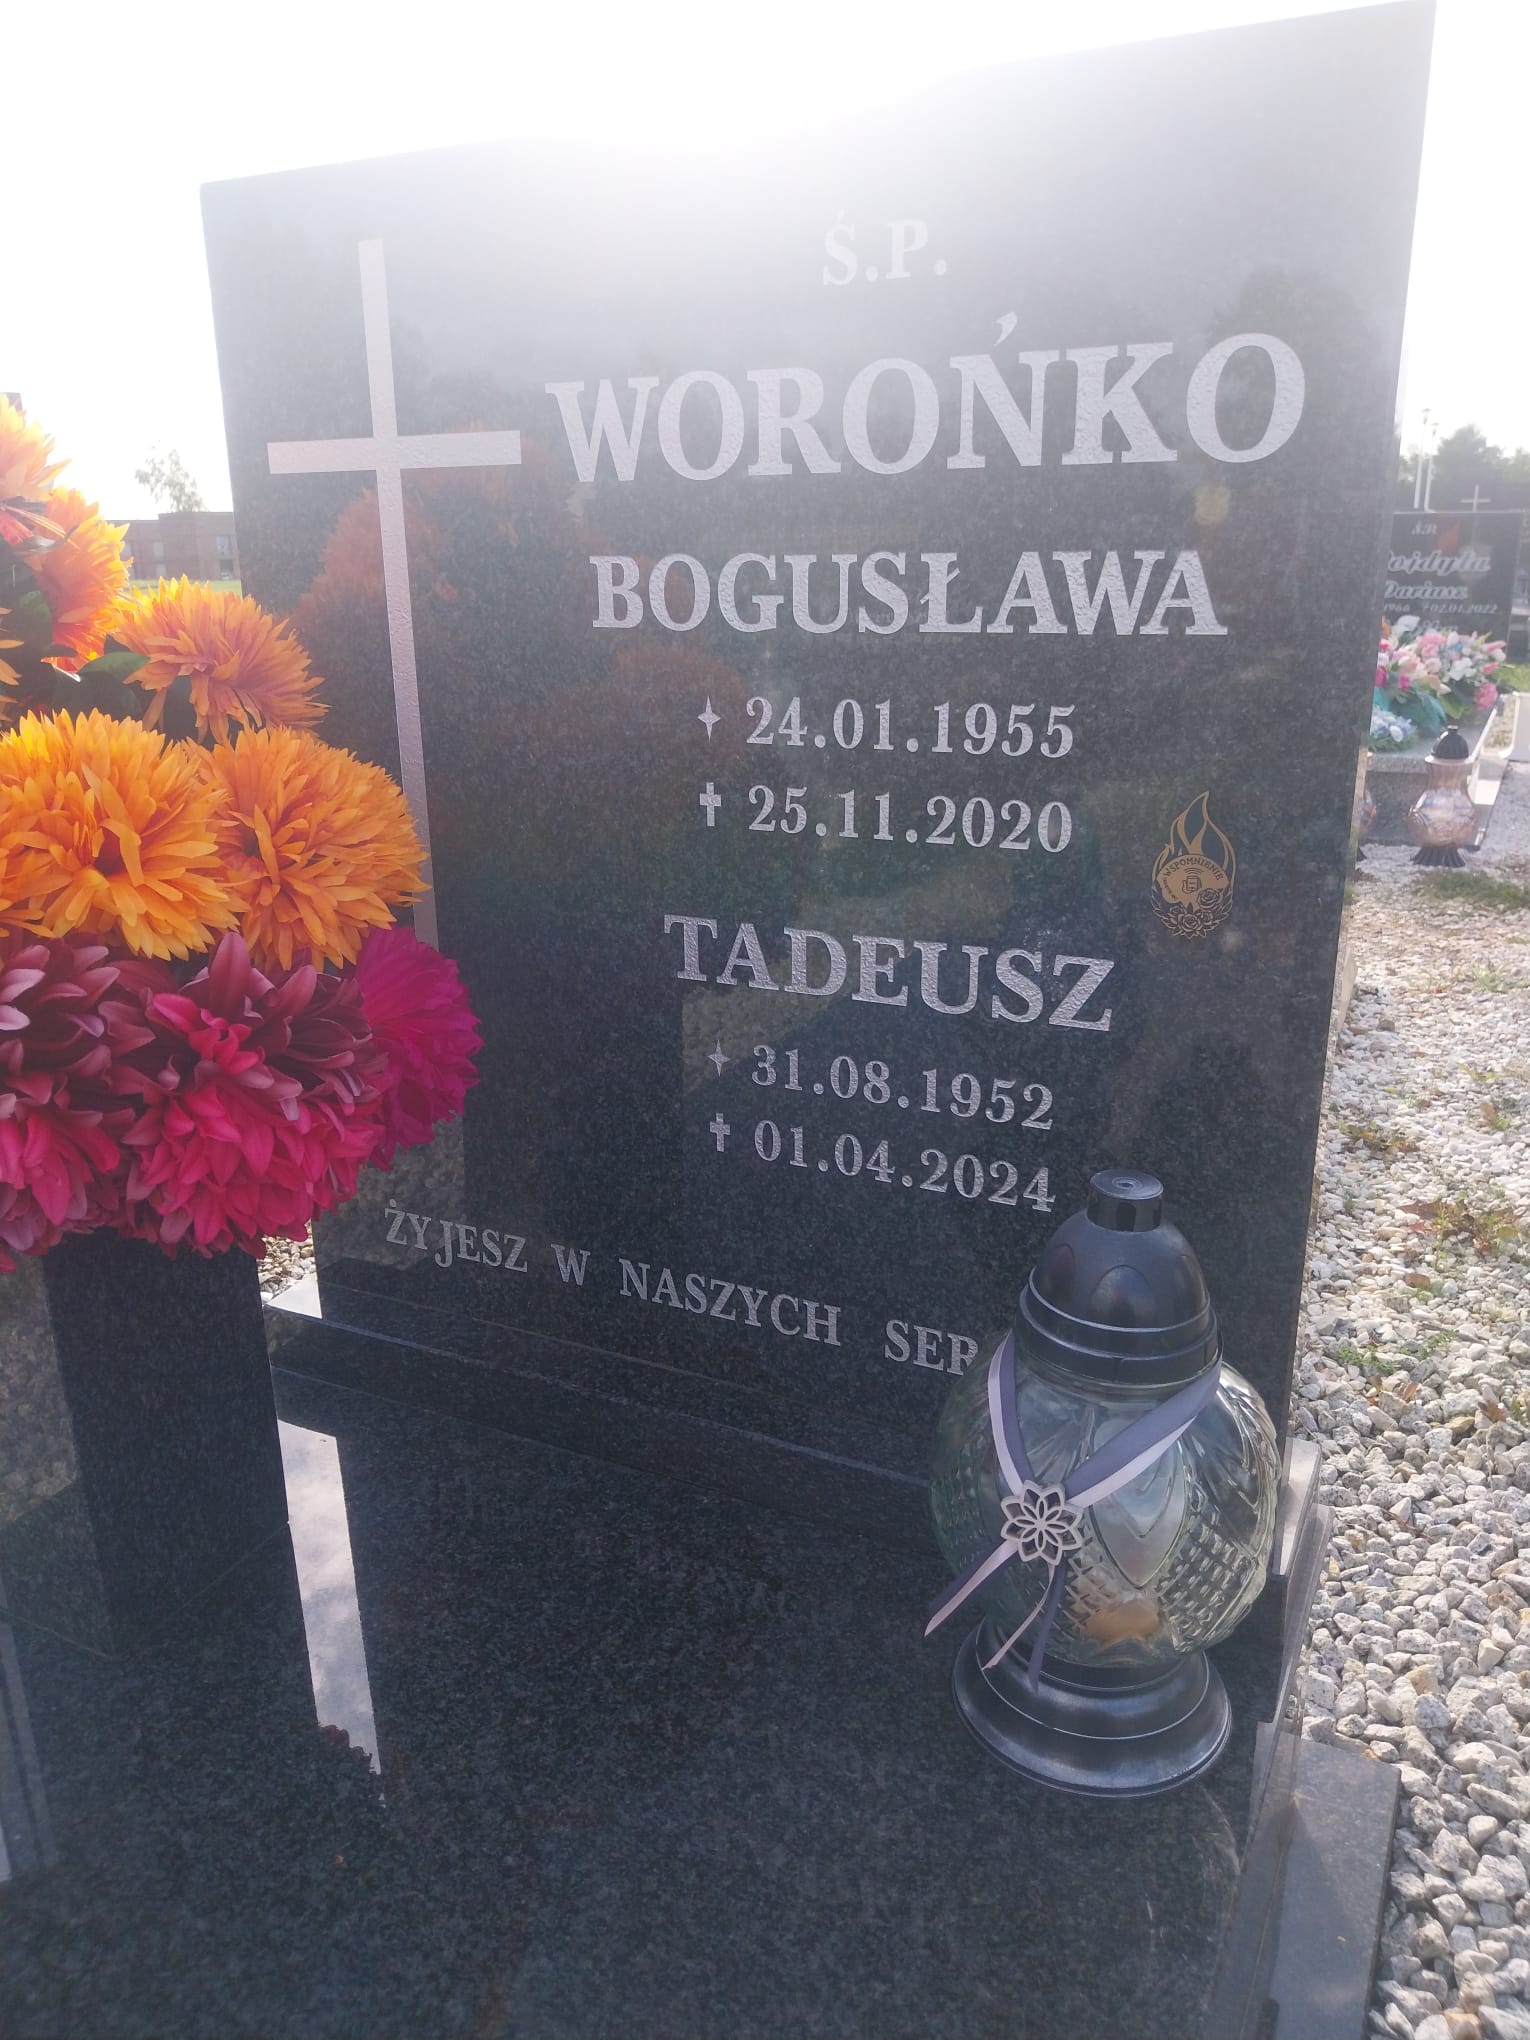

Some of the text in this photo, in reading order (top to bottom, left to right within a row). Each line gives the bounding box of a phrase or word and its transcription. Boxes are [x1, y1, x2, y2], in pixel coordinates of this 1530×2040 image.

[822, 208, 948, 286] Ś.P.
[544, 311, 1306, 483] WOROŃKO
[589, 550, 1228, 636] BOGUSŁAWA
[1387, 550, 1492, 577] ojdyła
[1384, 602, 1411, 613] 1966
[746, 696, 1076, 759] 24.01.1955
[748, 784, 1073, 853] 25.11.2020
[1163, 856, 1224, 881] WSPOMNIENIE
[663, 914, 1115, 1032] TADEUSZ
[752, 1044, 1055, 1131] 31.08.1952
[753, 1119, 1056, 1213] 01.04.2024
[384, 1199, 979, 1377] ŻYJESZ W NASZYCH SER
